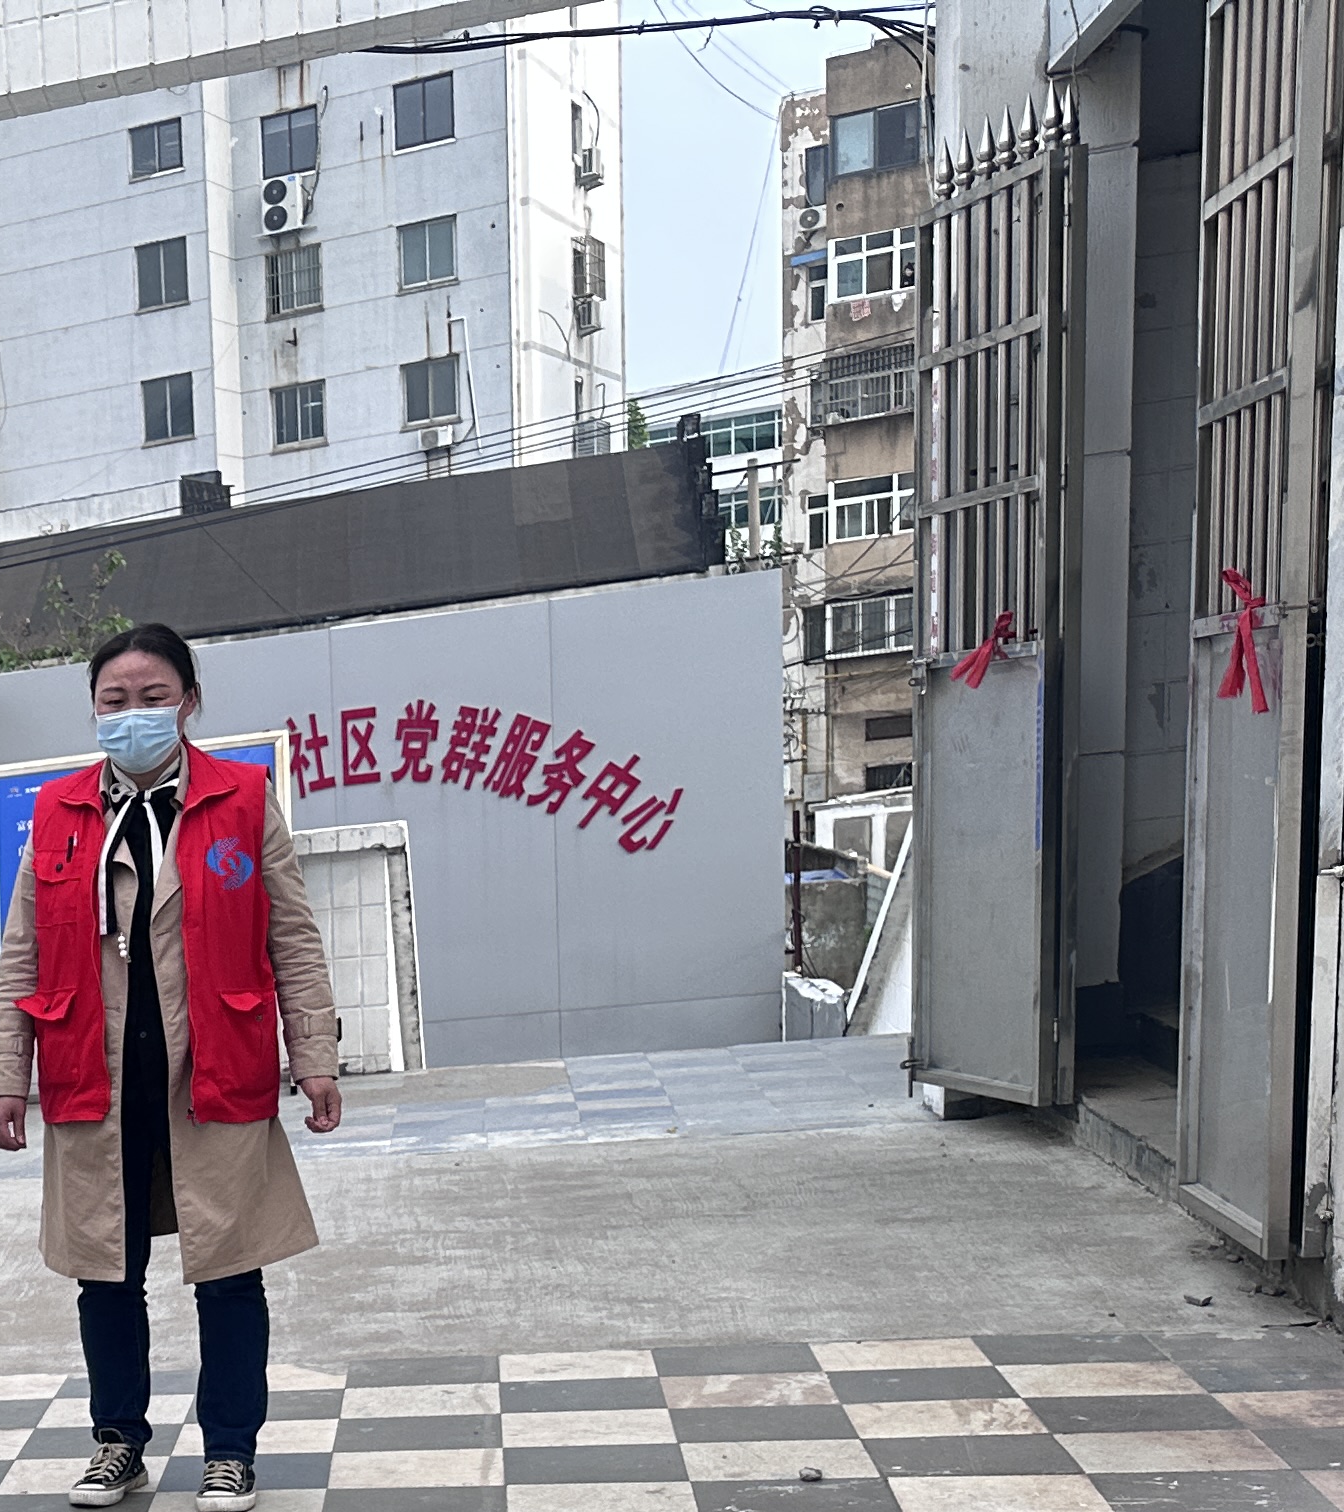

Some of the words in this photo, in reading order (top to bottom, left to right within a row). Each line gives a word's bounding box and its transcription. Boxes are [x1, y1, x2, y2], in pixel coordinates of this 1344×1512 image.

[286, 699, 684, 854] 社区党群服务中心
